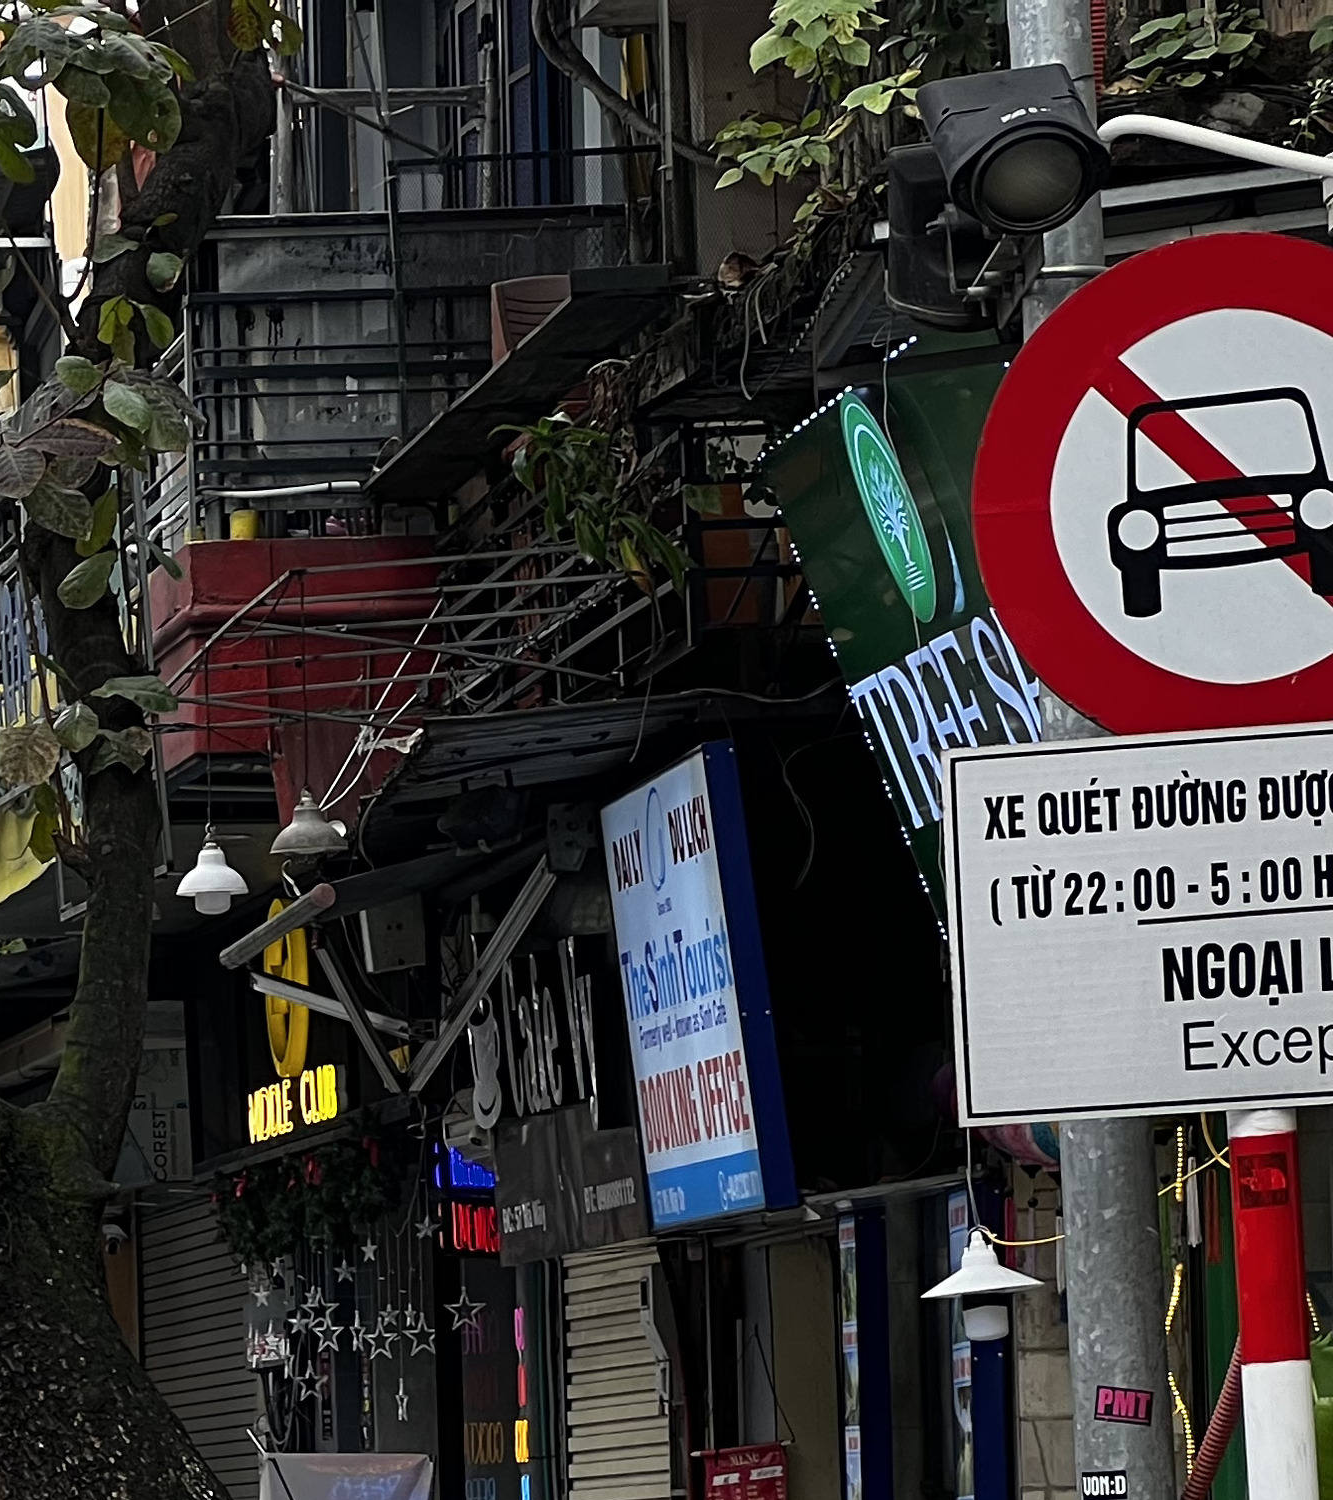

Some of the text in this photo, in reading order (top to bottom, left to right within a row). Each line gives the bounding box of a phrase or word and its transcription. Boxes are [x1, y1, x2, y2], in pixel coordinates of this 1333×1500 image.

[983, 769, 1333, 840] XE QUÉT ĐƯỜNG ĐƯỢ
[1011, 864, 1056, 919] TỪ
[1162, 938, 1304, 1006] NGOẠI
[638, 1049, 751, 1155] BOOKING OFFICE
[1096, 1387, 1152, 1419] PMT
